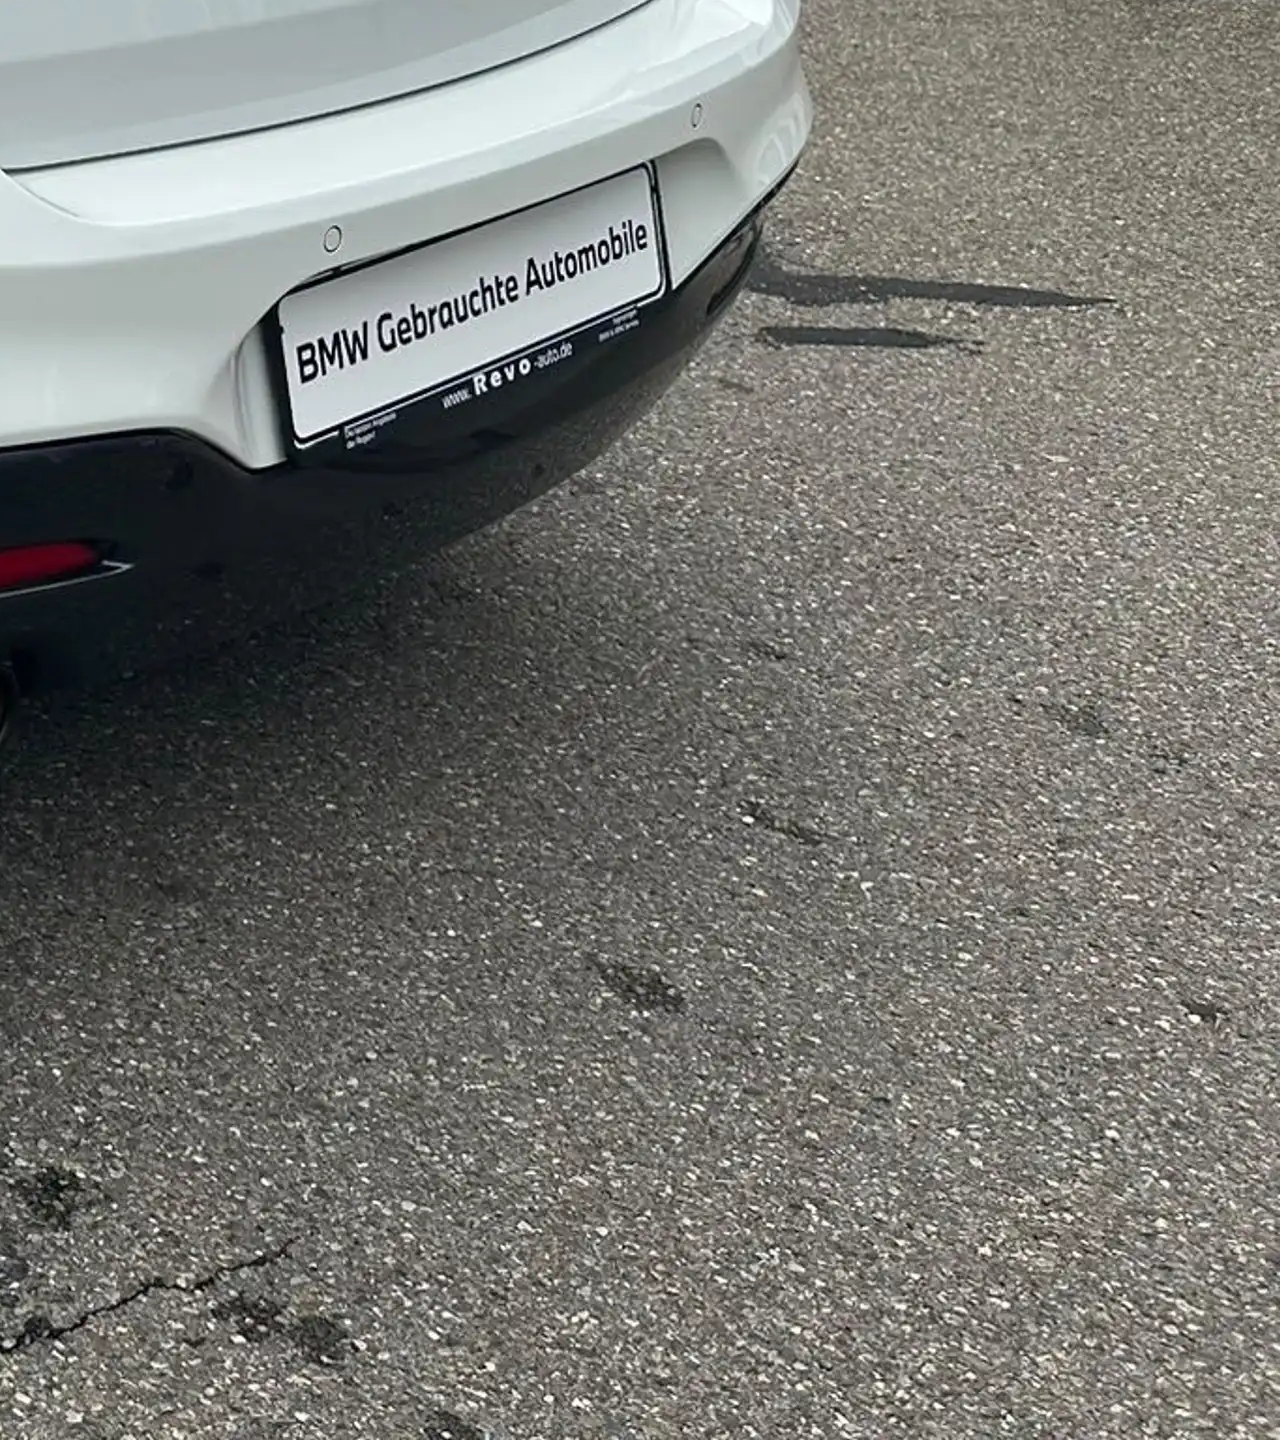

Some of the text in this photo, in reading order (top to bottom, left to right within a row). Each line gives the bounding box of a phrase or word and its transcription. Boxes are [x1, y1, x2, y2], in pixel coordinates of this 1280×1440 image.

[296, 321, 370, 384] BMW
[376, 272, 519, 353] Gebrauchte
[525, 219, 648, 296] Automobile
